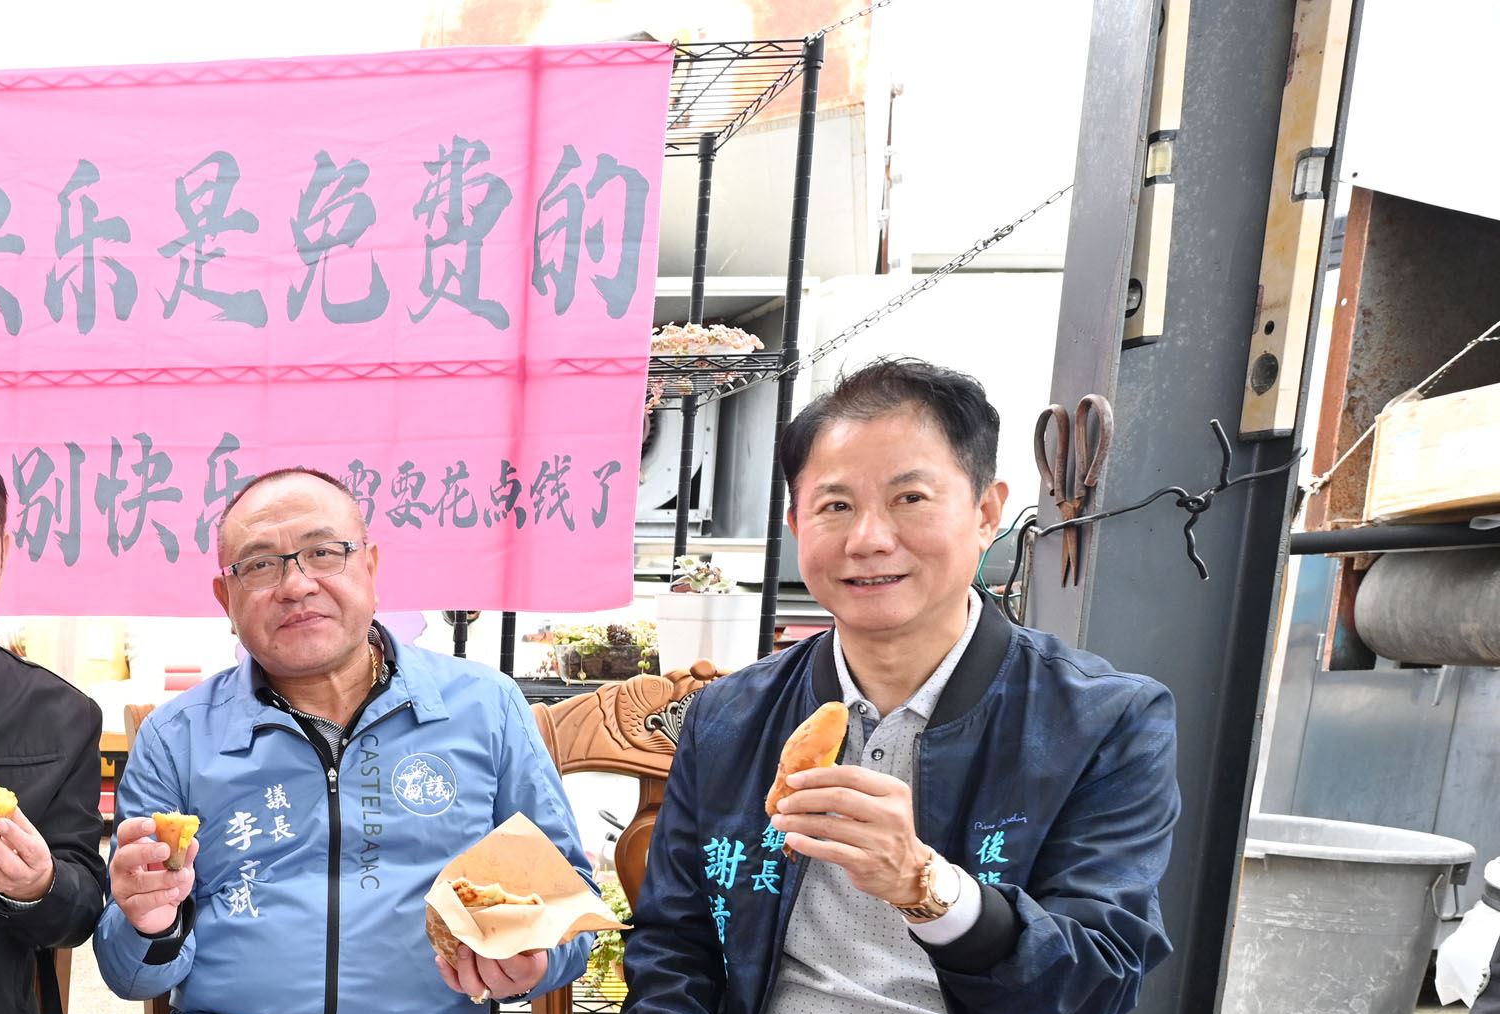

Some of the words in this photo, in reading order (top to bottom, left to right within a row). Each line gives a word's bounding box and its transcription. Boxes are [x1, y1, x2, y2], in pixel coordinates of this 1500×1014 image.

[264, 783, 296, 842] 議長
[360, 734, 382, 890] CASTELBAJAC
[703, 836, 747, 980] 謝清
